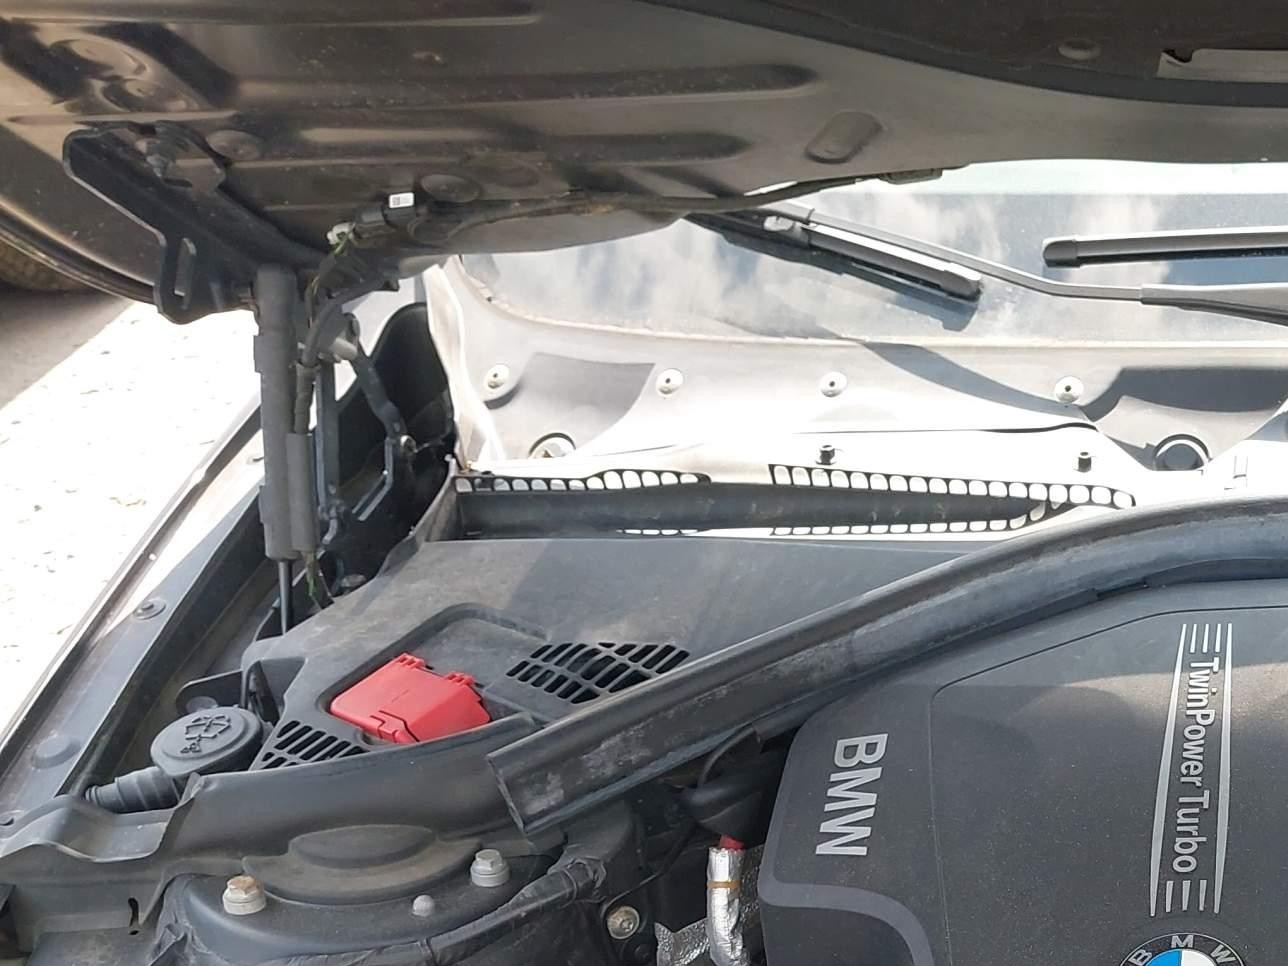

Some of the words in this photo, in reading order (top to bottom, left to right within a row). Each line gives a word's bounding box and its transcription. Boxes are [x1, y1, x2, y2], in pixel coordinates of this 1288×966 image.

[1180, 657, 1219, 787] TwinPower
[816, 733, 888, 855] BMW
[1172, 790, 1210, 873] Turbo
[1128, 934, 1237, 966] BMW
